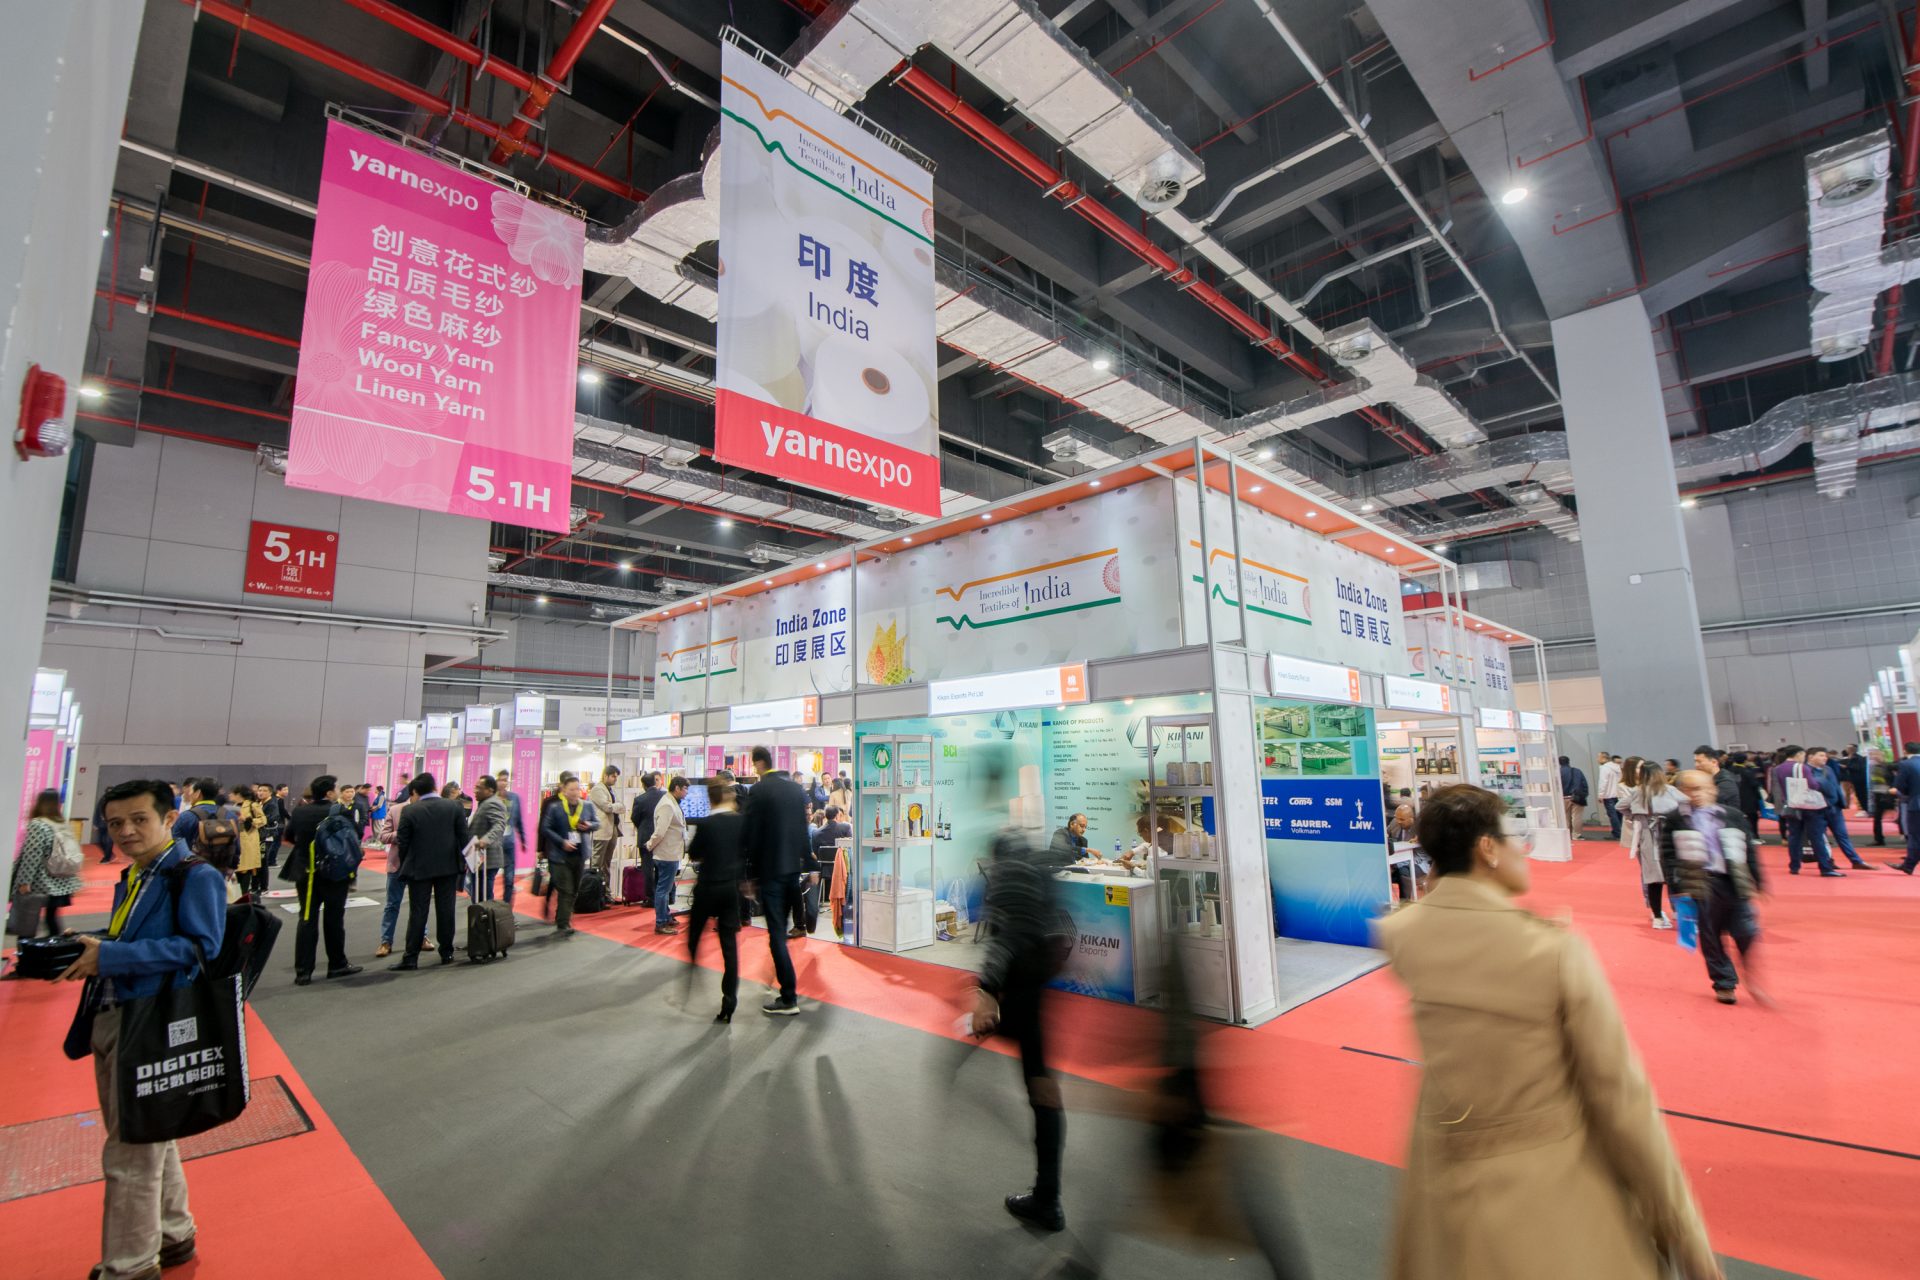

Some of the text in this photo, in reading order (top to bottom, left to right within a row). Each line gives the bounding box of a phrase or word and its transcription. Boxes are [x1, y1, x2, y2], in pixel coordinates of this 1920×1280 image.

[798, 146, 846, 184] Textiles of
[799, 133, 846, 168] Incredible
[349, 148, 479, 211] yarnexpo
[372, 224, 538, 298] 创意花式纱
[798, 233, 879, 307] 印度
[367, 257, 504, 318] 品质毛纱
[363, 288, 503, 348] 绿色麻纱
[808, 291, 869, 341] India
[361, 322, 494, 374] Fancy Yarn
[358, 347, 481, 395] Wool Yarn
[355, 374, 485, 421] Linen Yarn
[760, 420, 912, 488] yarnexpo
[466, 466, 551, 512] 5.1H
[263, 530, 326, 568] 5.1H
[979, 583, 1020, 601] Incredible
[979, 601, 1010, 614] Textiles
[1335, 577, 1388, 613] India Zone
[776, 607, 846, 636] India Zone
[1339, 609, 1391, 645] 印度展区
[775, 630, 846, 665] 印度展区
[943, 745, 957, 757] BCI
[1325, 797, 1343, 806] SSM
[1079, 944, 1108, 957] Exports
[1080, 934, 1120, 949] KIKANI
[136, 1046, 224, 1080] DIGITEX
